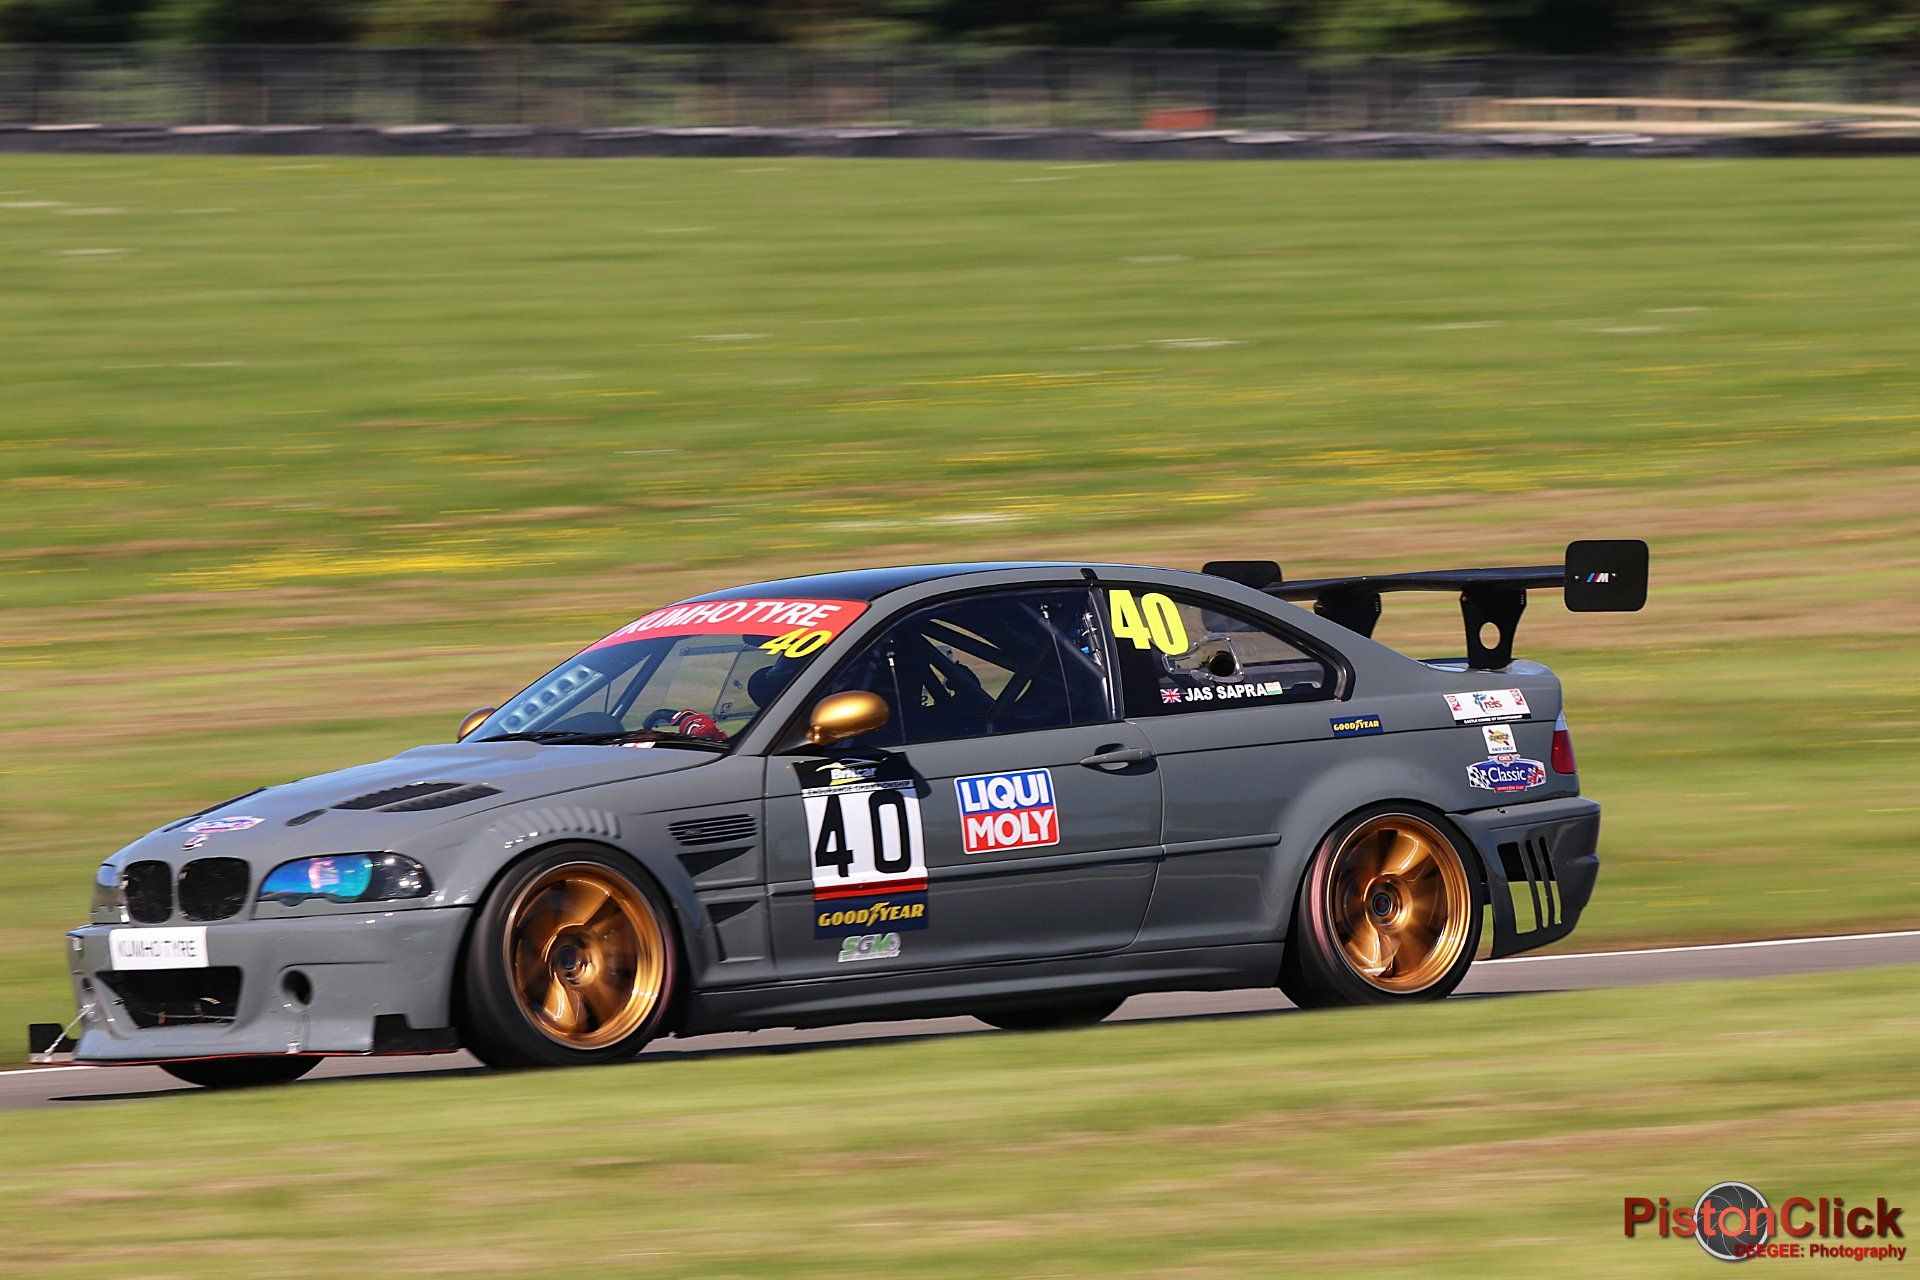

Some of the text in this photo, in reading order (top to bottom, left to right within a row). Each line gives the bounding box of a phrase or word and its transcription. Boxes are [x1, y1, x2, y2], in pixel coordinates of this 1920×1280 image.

[612, 601, 842, 638] KUMHO TYRE
[1109, 589, 1189, 656] 40
[758, 627, 833, 659] 40
[1185, 683, 1268, 702] JAS SAPRA
[1333, 719, 1380, 731] GOODYEAR
[1487, 766, 1527, 783] Classic
[960, 773, 1050, 812] LIQUI
[815, 790, 912, 878] 40
[966, 808, 1054, 849] MOLY
[818, 901, 926, 927] GOODYEAR
